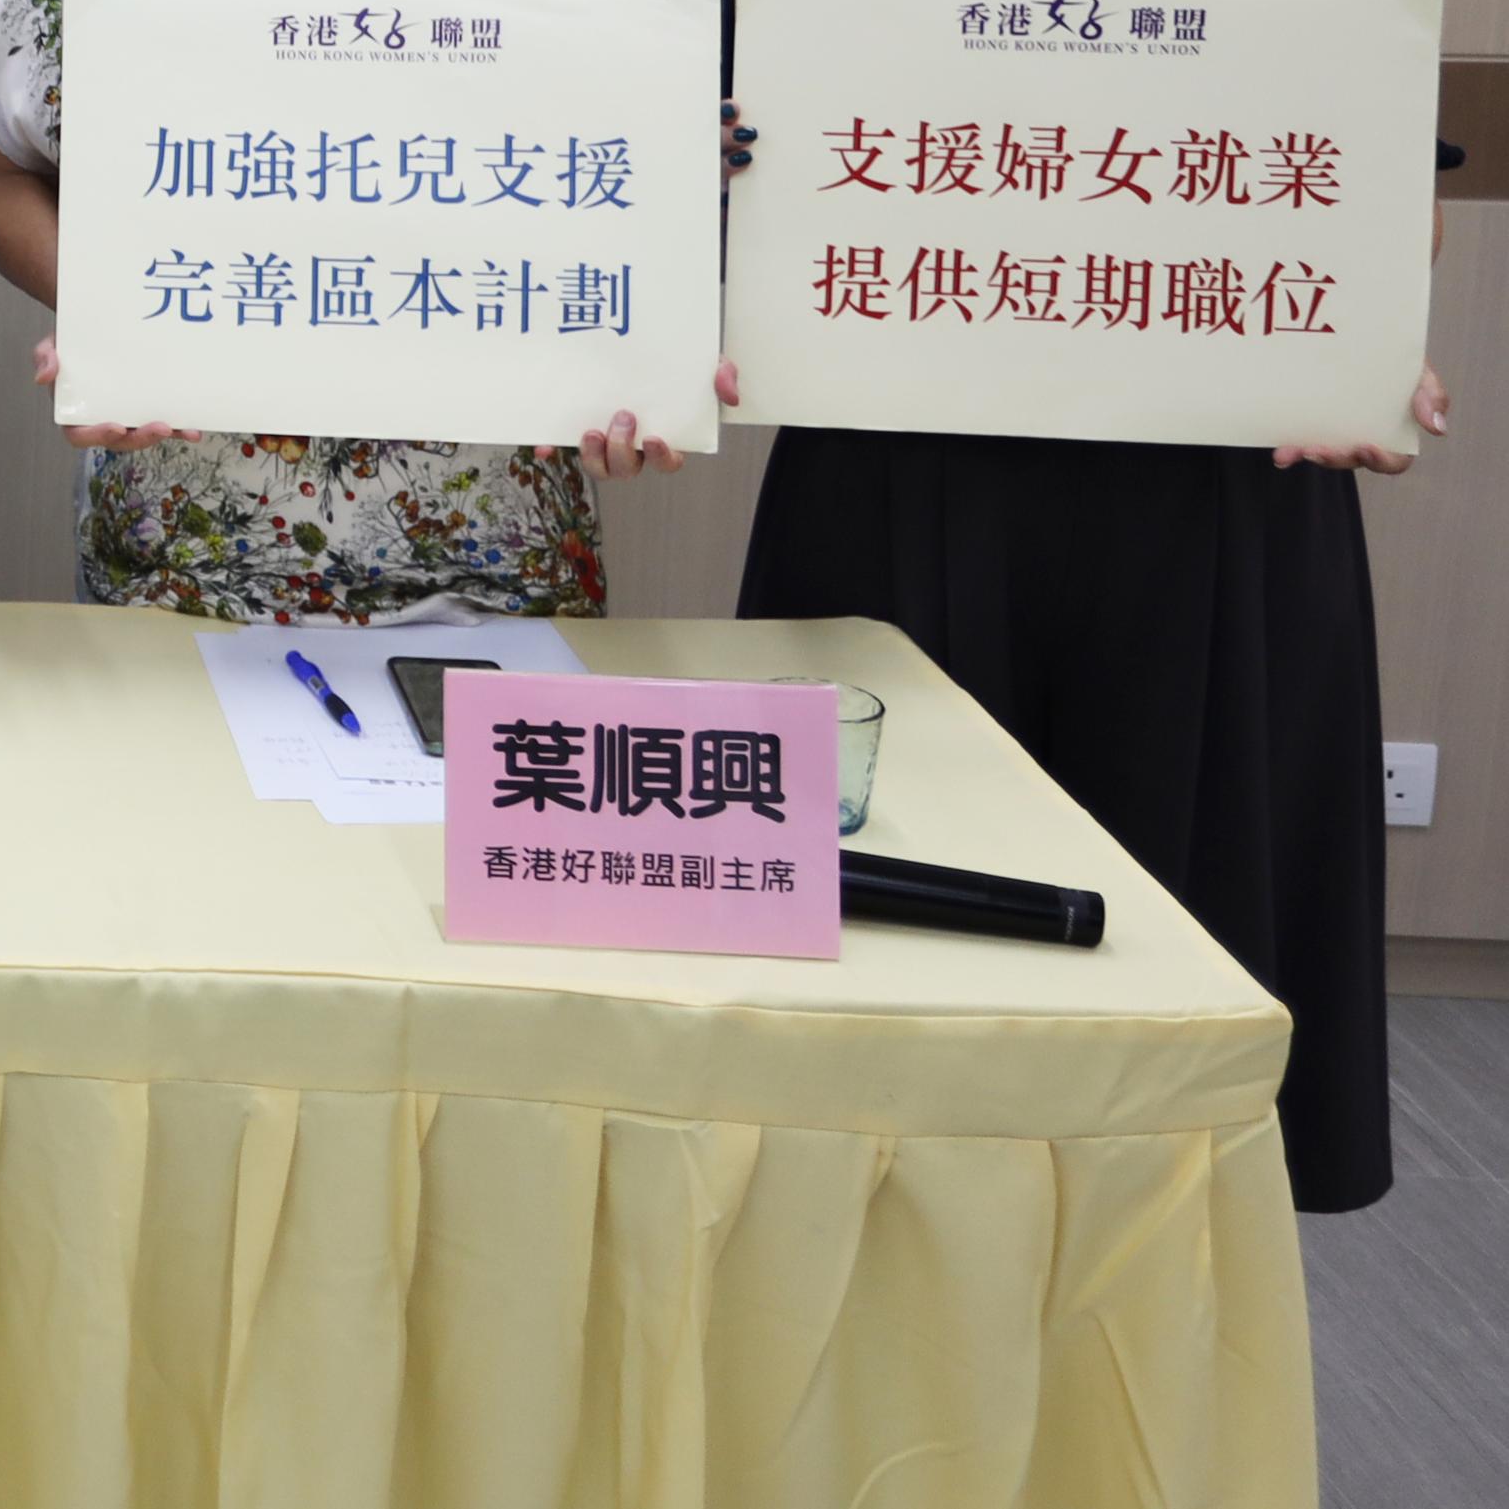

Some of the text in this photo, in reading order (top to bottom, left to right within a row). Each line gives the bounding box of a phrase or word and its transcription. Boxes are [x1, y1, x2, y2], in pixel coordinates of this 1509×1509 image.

[276, 49, 497, 64] HONG KONG WOMEN'S UNION
[963, 38, 1201, 56] HONG KONG WOMEN'S UNION
[143, 126, 636, 210] 加強托兒支援
[816, 116, 1343, 209] 支援婦女就業
[142, 248, 633, 337] 完善區本計劃
[811, 243, 1336, 336] 提供短期職位
[492, 719, 786, 824] 葉順興
[483, 845, 797, 894] 香港好聯盟副主席
